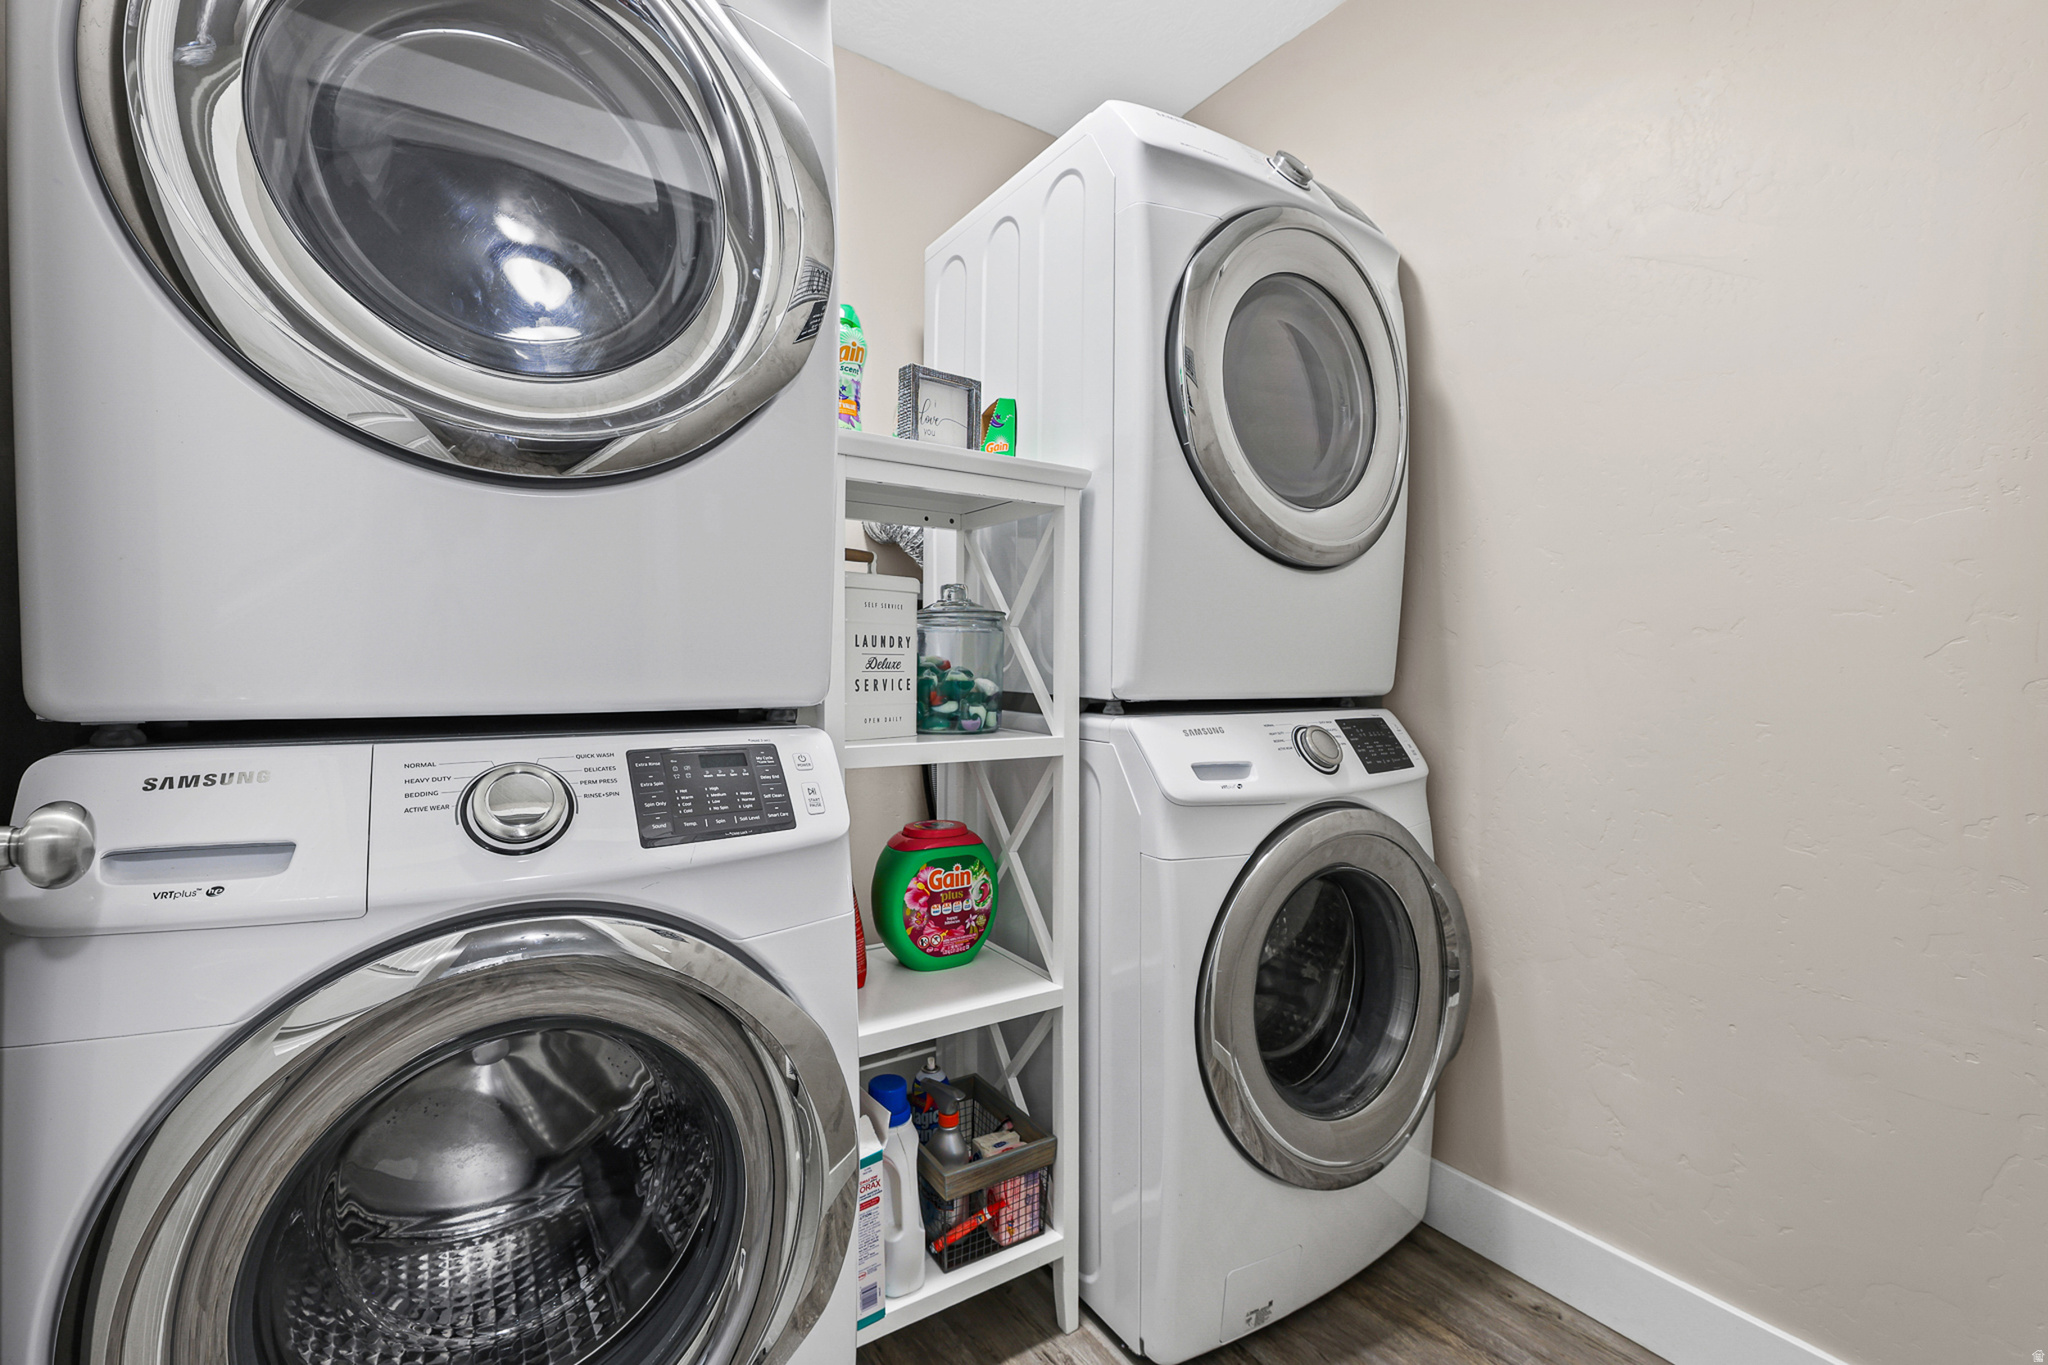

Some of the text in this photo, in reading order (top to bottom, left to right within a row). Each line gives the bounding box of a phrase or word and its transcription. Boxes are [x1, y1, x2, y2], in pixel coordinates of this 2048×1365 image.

[840, 341, 865, 364] ain
[840, 364, 860, 376] scent
[986, 442, 1009, 453] Gain
[880, 602, 903, 610] SERVICE
[854, 634, 911, 648] LAUNDRY
[865, 656, 902, 670] Deluxe
[854, 678, 911, 692] SERVICE
[1182, 726, 1225, 737] SAMSUNG
[142, 770, 272, 792] SAMSUNG
[404, 790, 439, 798] BEDDING
[928, 865, 972, 890] Gain
[940, 890, 964, 902] plus
[860, 1178, 881, 1194] ORAX
